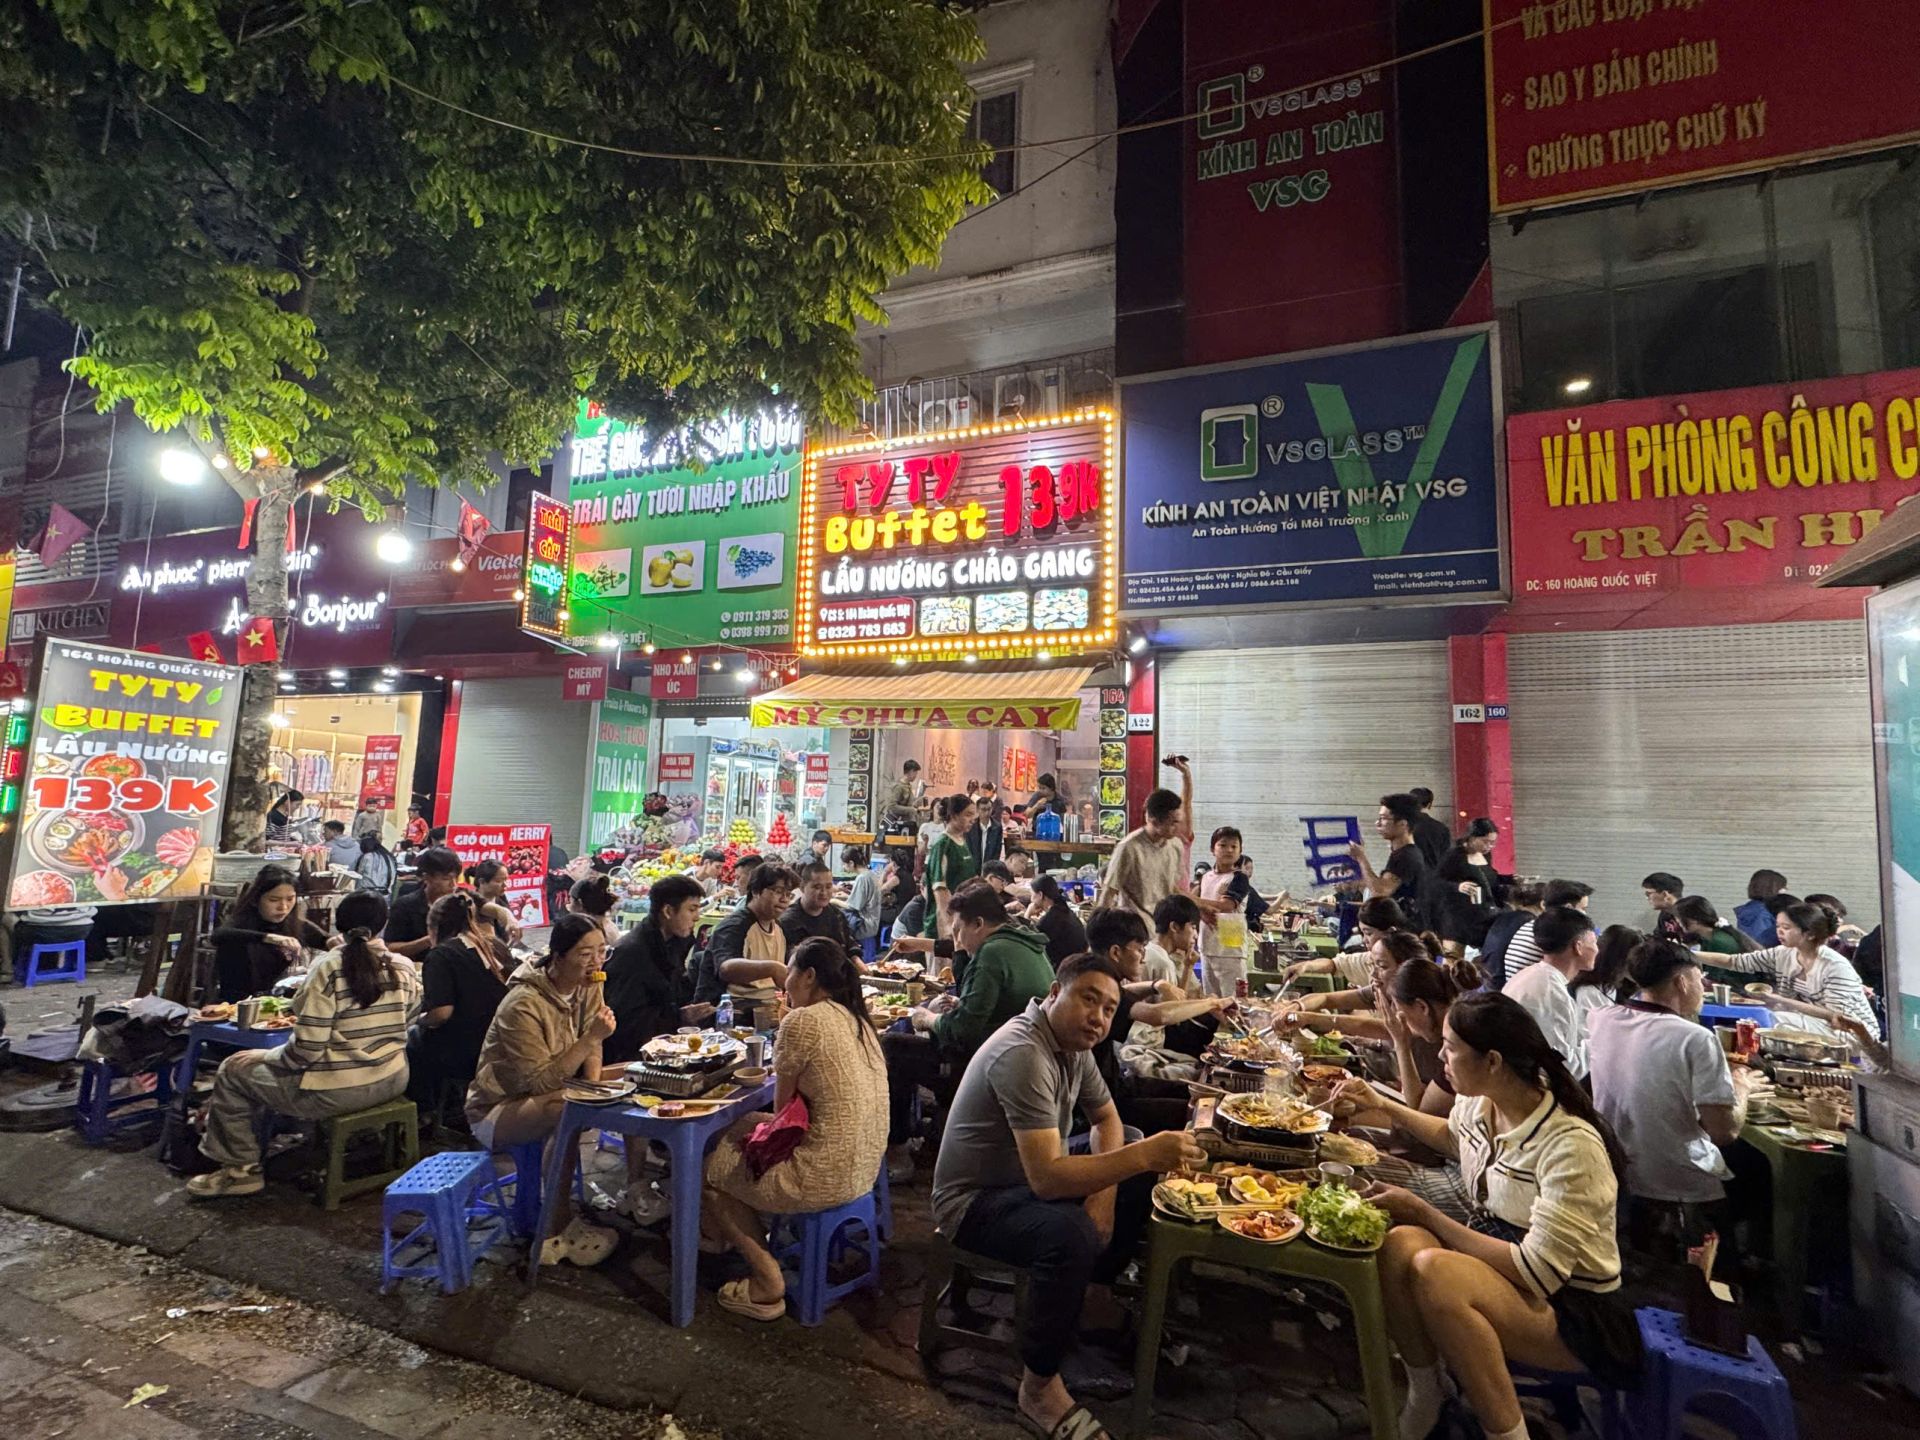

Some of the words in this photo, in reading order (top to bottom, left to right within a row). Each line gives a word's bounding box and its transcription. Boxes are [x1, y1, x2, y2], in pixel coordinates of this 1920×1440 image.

[1524, 70, 1567, 110] SAO
[1572, 66, 1585, 101] Y
[1592, 48, 1642, 98] BẢN
[1646, 36, 1718, 87] CHÍNH
[1198, 139, 1257, 180] KÍNH
[1265, 128, 1304, 165] AN
[1312, 110, 1384, 155] TOÀN
[1526, 132, 1604, 179] CHỨNG
[1734, 94, 1768, 141] KÝ
[1247, 169, 1331, 212] VSG
[1541, 417, 1617, 508] VĂN
[1626, 404, 1757, 501] PHÒNG
[1762, 394, 1879, 488] CÔNG
[572, 490, 608, 525] TRÁI
[611, 488, 642, 521] CÂY
[647, 485, 685, 516] TƯƠI
[688, 477, 738, 514] NHẬP
[741, 459, 790, 504] KHẨU
[1142, 499, 1188, 525] KÍNH
[1193, 501, 1225, 521] AN
[1230, 489, 1290, 518] TOÀN
[1296, 484, 1340, 514] VIỆT
[1346, 480, 1407, 510] NHẬT
[1414, 477, 1468, 499] VSG
[540, 508, 564, 532] TRÁI
[1192, 527, 1207, 538] An
[1210, 522, 1239, 536] Toàn
[1240, 520, 1278, 537] Hướng
[1281, 519, 1299, 531] Tới
[1301, 516, 1324, 529] Môi
[1328, 512, 1370, 528] Trường
[1377, 511, 1410, 522] Xanh
[1572, 503, 1779, 562] TRẦN
[820, 556, 865, 595] LẨU
[869, 557, 947, 592] NƯỚNG
[952, 546, 1018, 587] CHẢO
[1023, 548, 1094, 580] GANG
[1156, 576, 1169, 584] 162
[1408, 569, 1456, 579] vsg.com.vn
[1545, 579, 1560, 590] 160
[1564, 575, 1598, 589] HOÀNG
[1602, 570, 1630, 587] QUỐC
[1635, 571, 1657, 587] VIỆT
[303, 593, 378, 633] Bonjour
[732, 611, 755, 622] 0911
[757, 610, 771, 621] 319
[753, 626, 771, 637] 999
[772, 624, 789, 636] 789
[61, 648, 94, 661] 164
[97, 653, 156, 670] HOÀNG
[158, 662, 200, 676] QUỐC
[203, 669, 235, 682] VIỆT
[567, 666, 603, 679] CHERRY
[653, 664, 672, 677] NHO
[674, 662, 697, 676] XANH
[576, 682, 592, 696] MỸ
[666, 680, 681, 694] ÚC
[1101, 688, 1125, 705] 164
[53, 703, 220, 739] BUFFET
[838, 706, 954, 728] CHUA
[966, 705, 1061, 728] CAY
[1131, 718, 1150, 728] A22
[1459, 708, 1480, 718] 162
[1487, 707, 1506, 717] 160
[35, 731, 107, 756] LẨU
[116, 741, 229, 765] NƯỚNG
[597, 749, 622, 792] TRÁI
[623, 752, 645, 794] CÂY
[31, 775, 219, 815] 139K
[508, 827, 547, 841] HERRY
